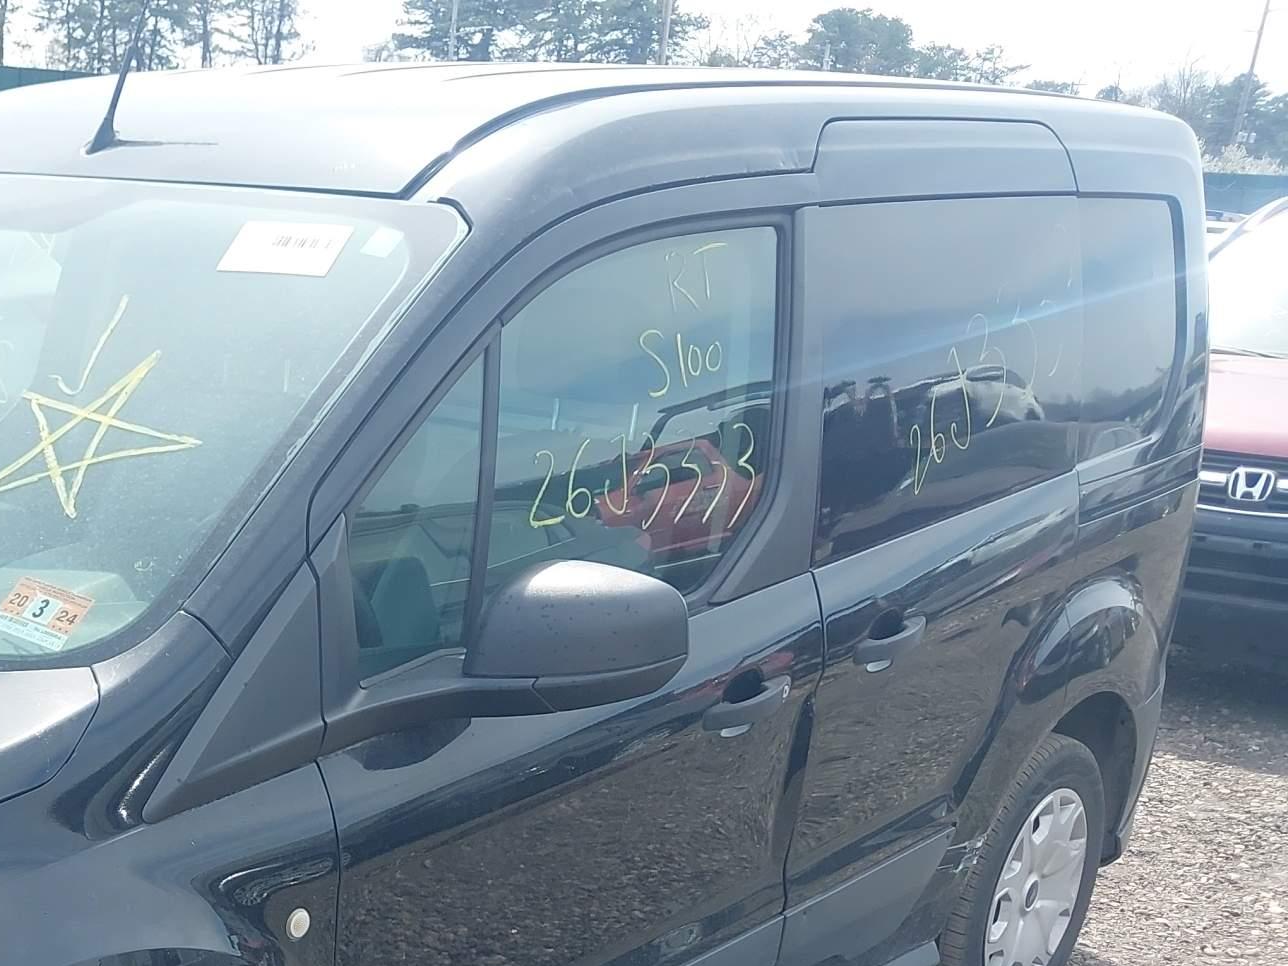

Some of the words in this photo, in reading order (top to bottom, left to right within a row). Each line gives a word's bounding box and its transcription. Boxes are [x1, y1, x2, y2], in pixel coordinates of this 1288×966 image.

[664, 242, 728, 313] RT
[638, 328, 723, 398] S100
[9, 592, 30, 608] 20
[32, 598, 51, 619] 3
[55, 610, 79, 627] 24
